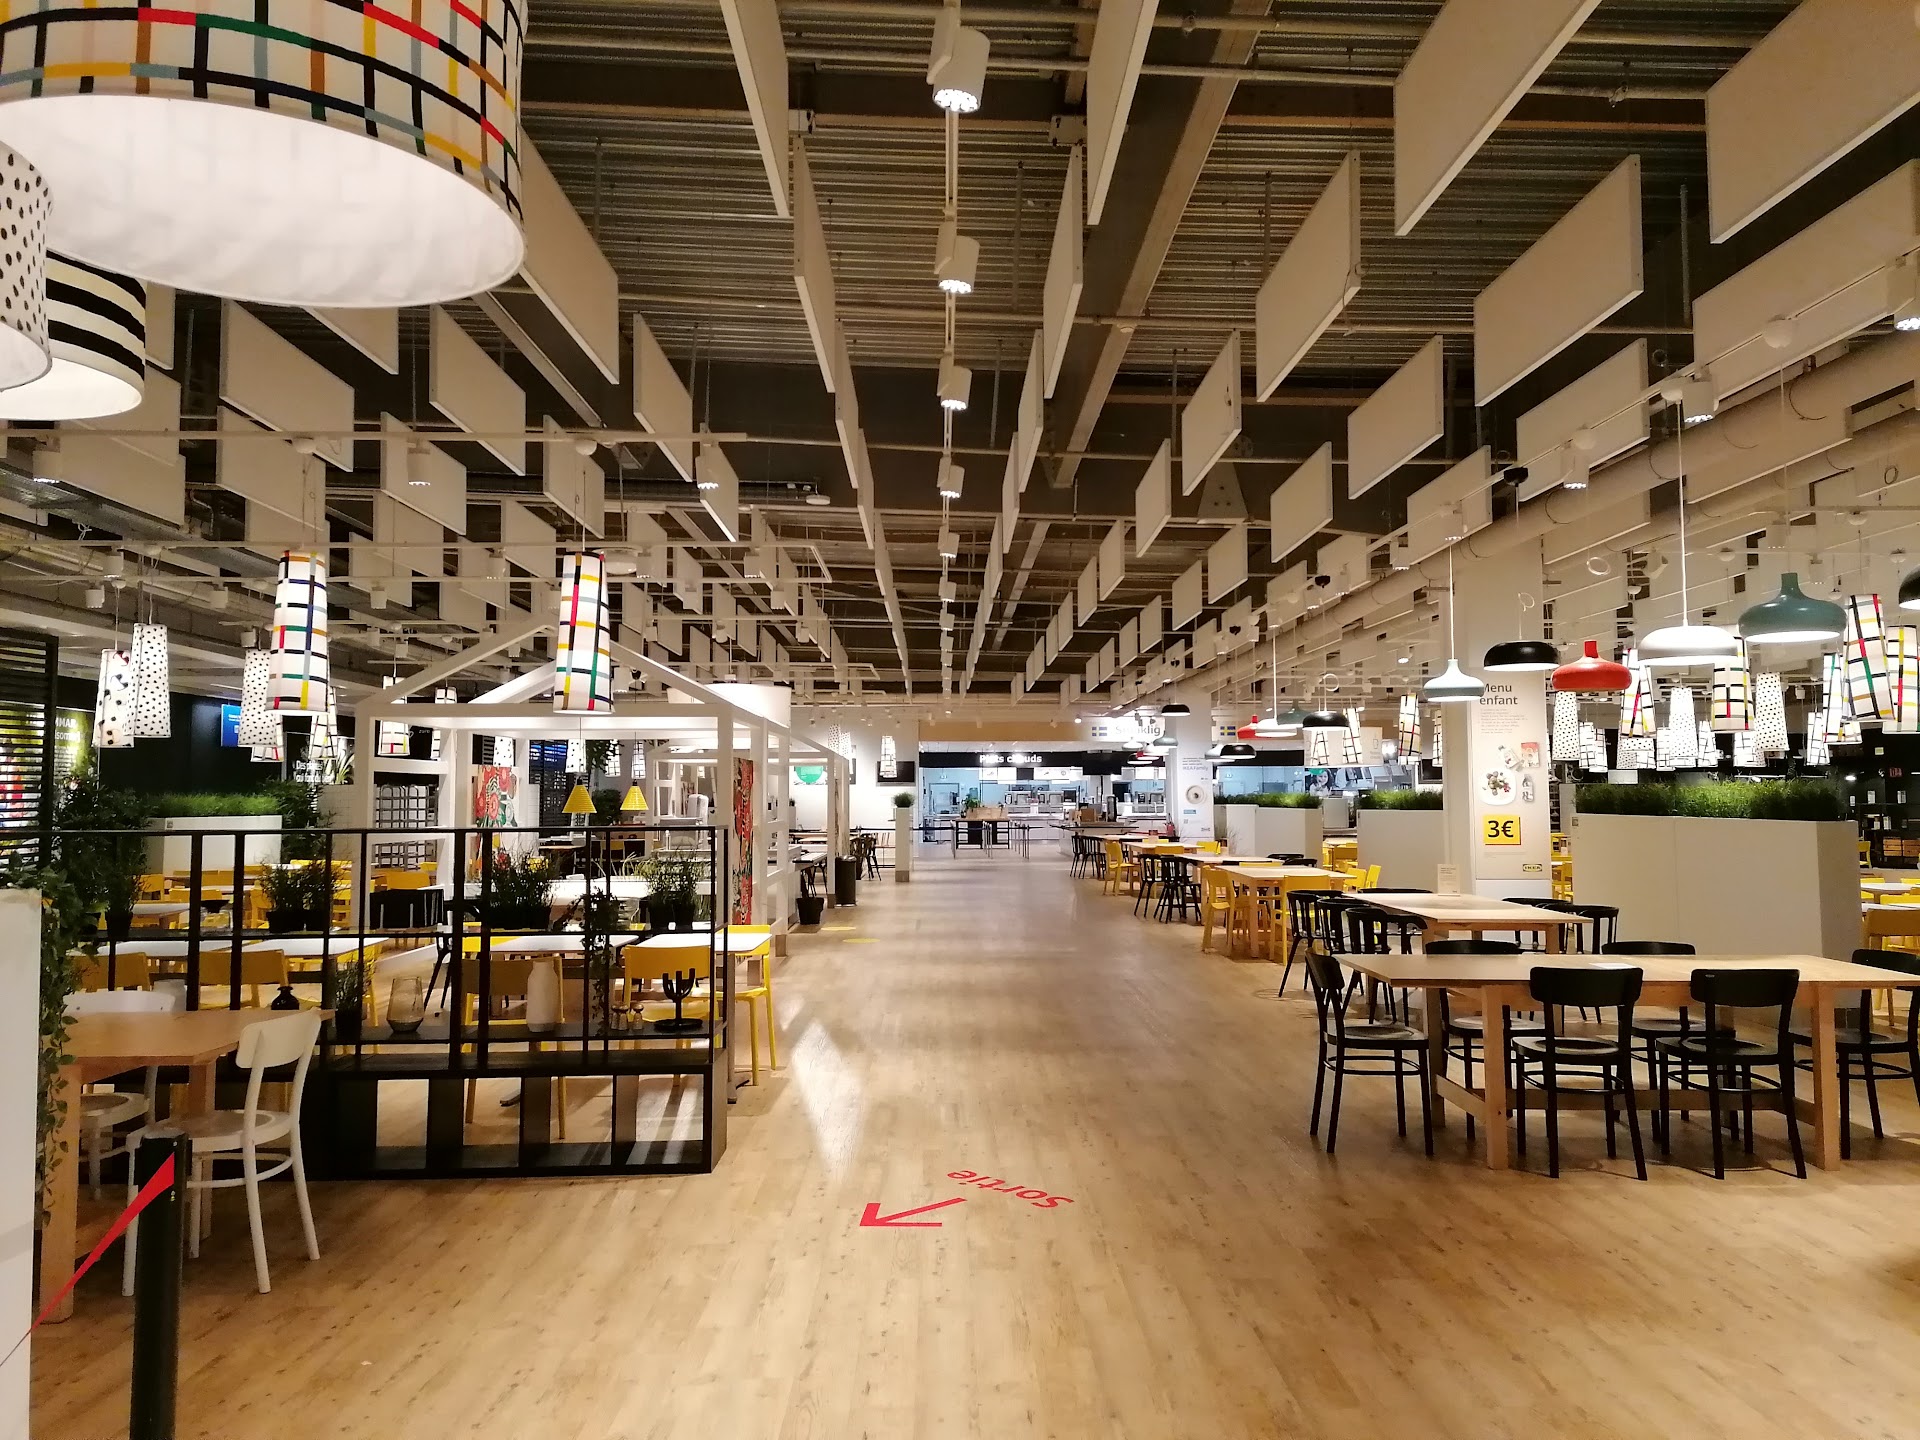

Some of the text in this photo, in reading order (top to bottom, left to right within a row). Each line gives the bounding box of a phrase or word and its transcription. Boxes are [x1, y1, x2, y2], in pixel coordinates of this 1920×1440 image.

[1479, 695, 1518, 705] enfant
[979, 753, 1042, 764] Plts chuds
[1487, 820, 1514, 838] 3€
[947, 1170, 1075, 1208] Sortie
